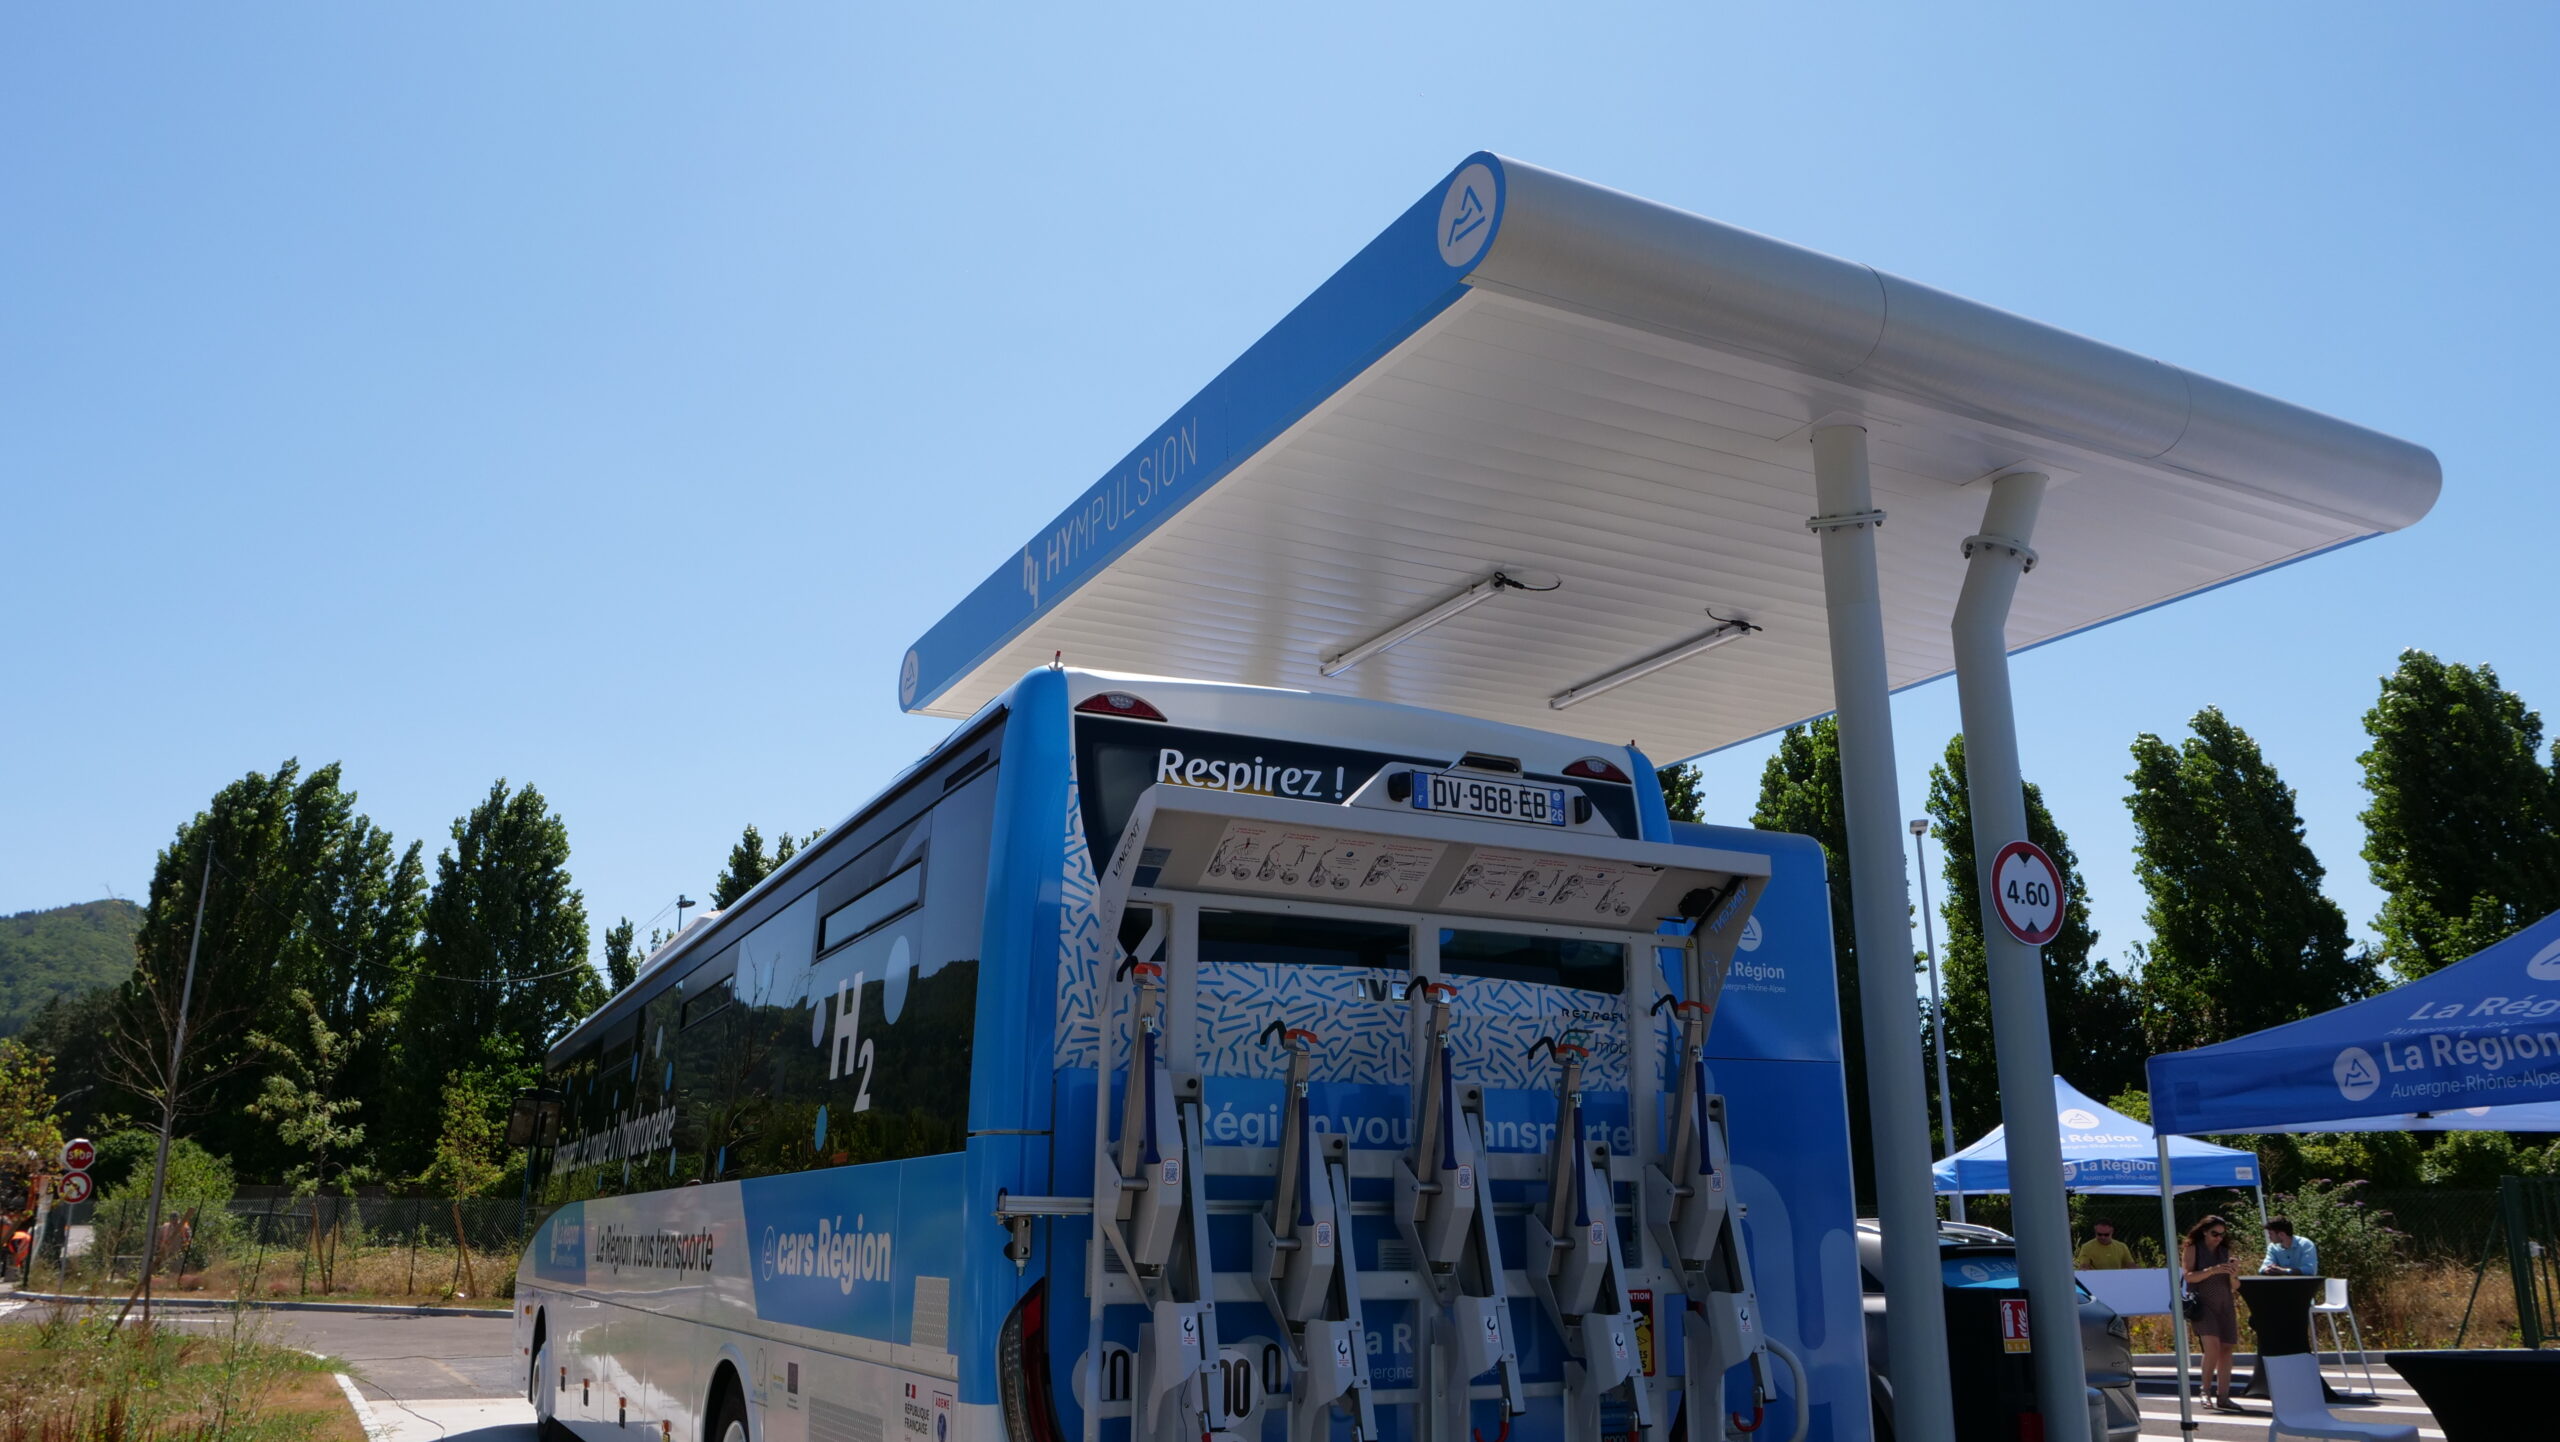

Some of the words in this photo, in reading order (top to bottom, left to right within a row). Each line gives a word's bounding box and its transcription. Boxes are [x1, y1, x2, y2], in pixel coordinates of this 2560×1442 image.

[1047, 416, 1197, 582] HYMPULSION
[1157, 748, 1322, 797] Respirez
[1334, 766, 1345, 799] !
[1433, 779, 1546, 818] DV-968-EB
[1551, 809, 1564, 822] 26
[1112, 818, 1141, 877] VINCENT
[2007, 880, 2050, 907] 4.60
[1722, 983, 1786, 993] vergne-Rhône-Alpes
[1735, 962, 1785, 981] Région
[2408, 1002, 2464, 1020] La
[2467, 994, 2560, 1018] Rég
[2384, 1041, 2424, 1073] La
[2430, 1029, 2560, 1070] Région
[2391, 1068, 2560, 1098] Auvergne-Rhône-Alpe
[615, 1094, 677, 1171] l'hydrogène
[1203, 1102, 1331, 1149] Régin
[1342, 1116, 1416, 1145] vou
[1484, 1119, 1632, 1154] ansprte
[2081, 1161, 2098, 1171] La
[596, 1226, 605, 1262] La
[606, 1224, 632, 1275] Région
[633, 1234, 655, 1268] vous
[656, 1227, 713, 1280] transporte
[777, 1233, 814, 1277] cars
[816, 1213, 892, 1295] Région
[904, 1400, 930, 1421] RÉPUBLIQUE
[904, 1417, 928, 1435] FRANÇAISE
